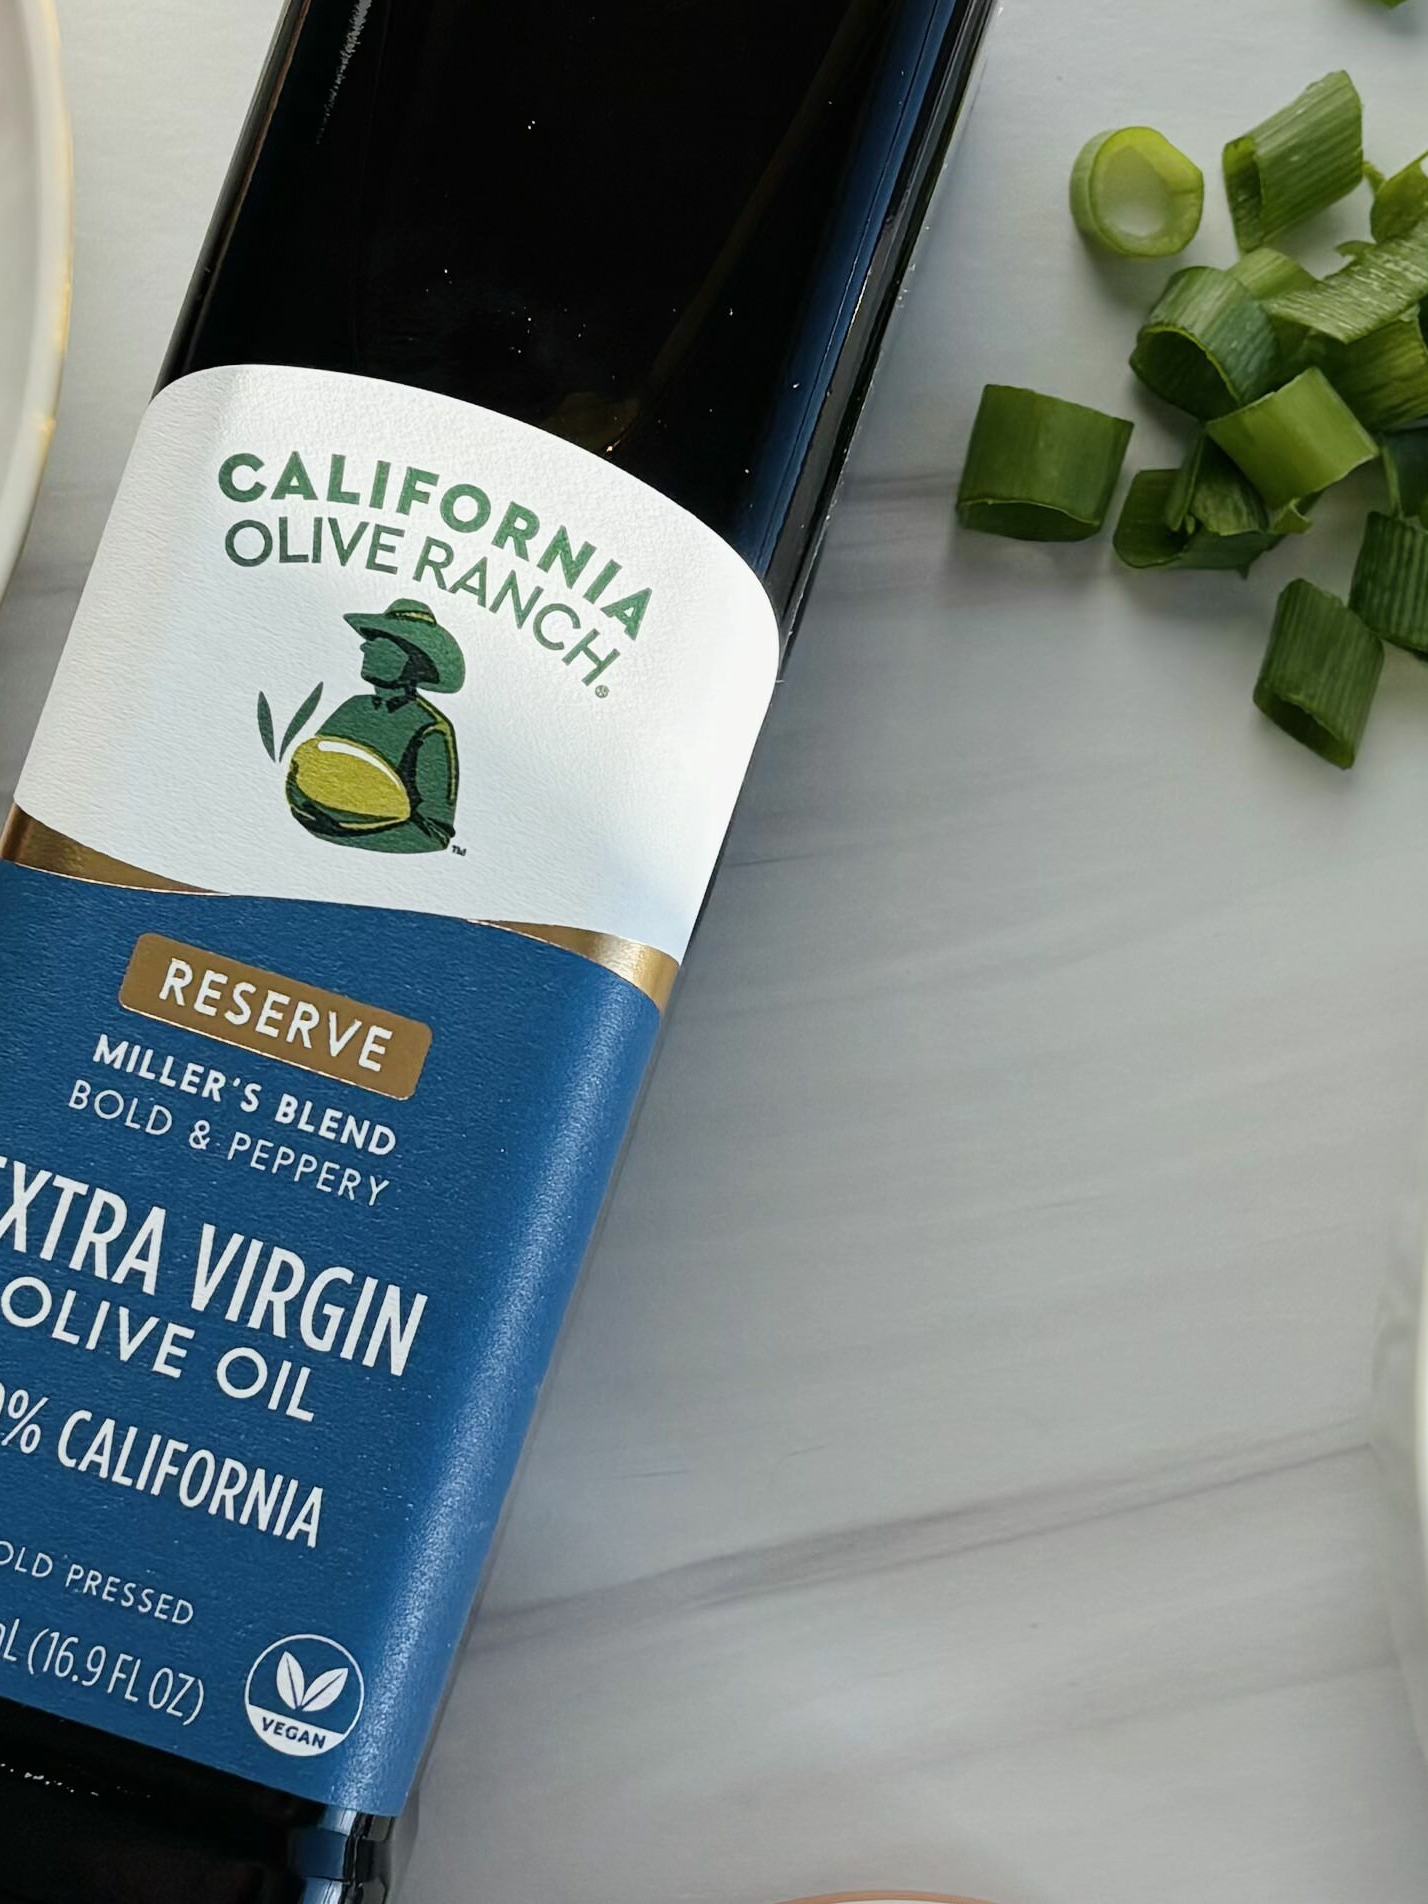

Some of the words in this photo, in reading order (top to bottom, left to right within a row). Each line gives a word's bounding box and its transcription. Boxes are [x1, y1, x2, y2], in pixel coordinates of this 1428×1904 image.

[217, 450, 653, 641] CALIFORNIA
[224, 515, 406, 575] OLIVE
[158, 957, 393, 1072] RESERVE
[67, 1079, 173, 1136] BOLD
[187, 1119, 212, 1151] &
[226, 1131, 391, 1207] PEPPERY
[92, 1033, 263, 1113] MILLER'S
[274, 1093, 397, 1157] BLEND
[0, 1275, 196, 1379] OLIVE
[215, 1346, 316, 1423] OIL
[190, 1222, 429, 1377] VIRGIN
[57, 1408, 325, 1549] CALIFORNIA
[64, 1563, 195, 1625] PRESSED
[26, 1627, 107, 1687] (16.9
[106, 1652, 142, 1703] FL
[147, 1667, 205, 1726] OZ)
[261, 1715, 327, 1750] VEGAN
